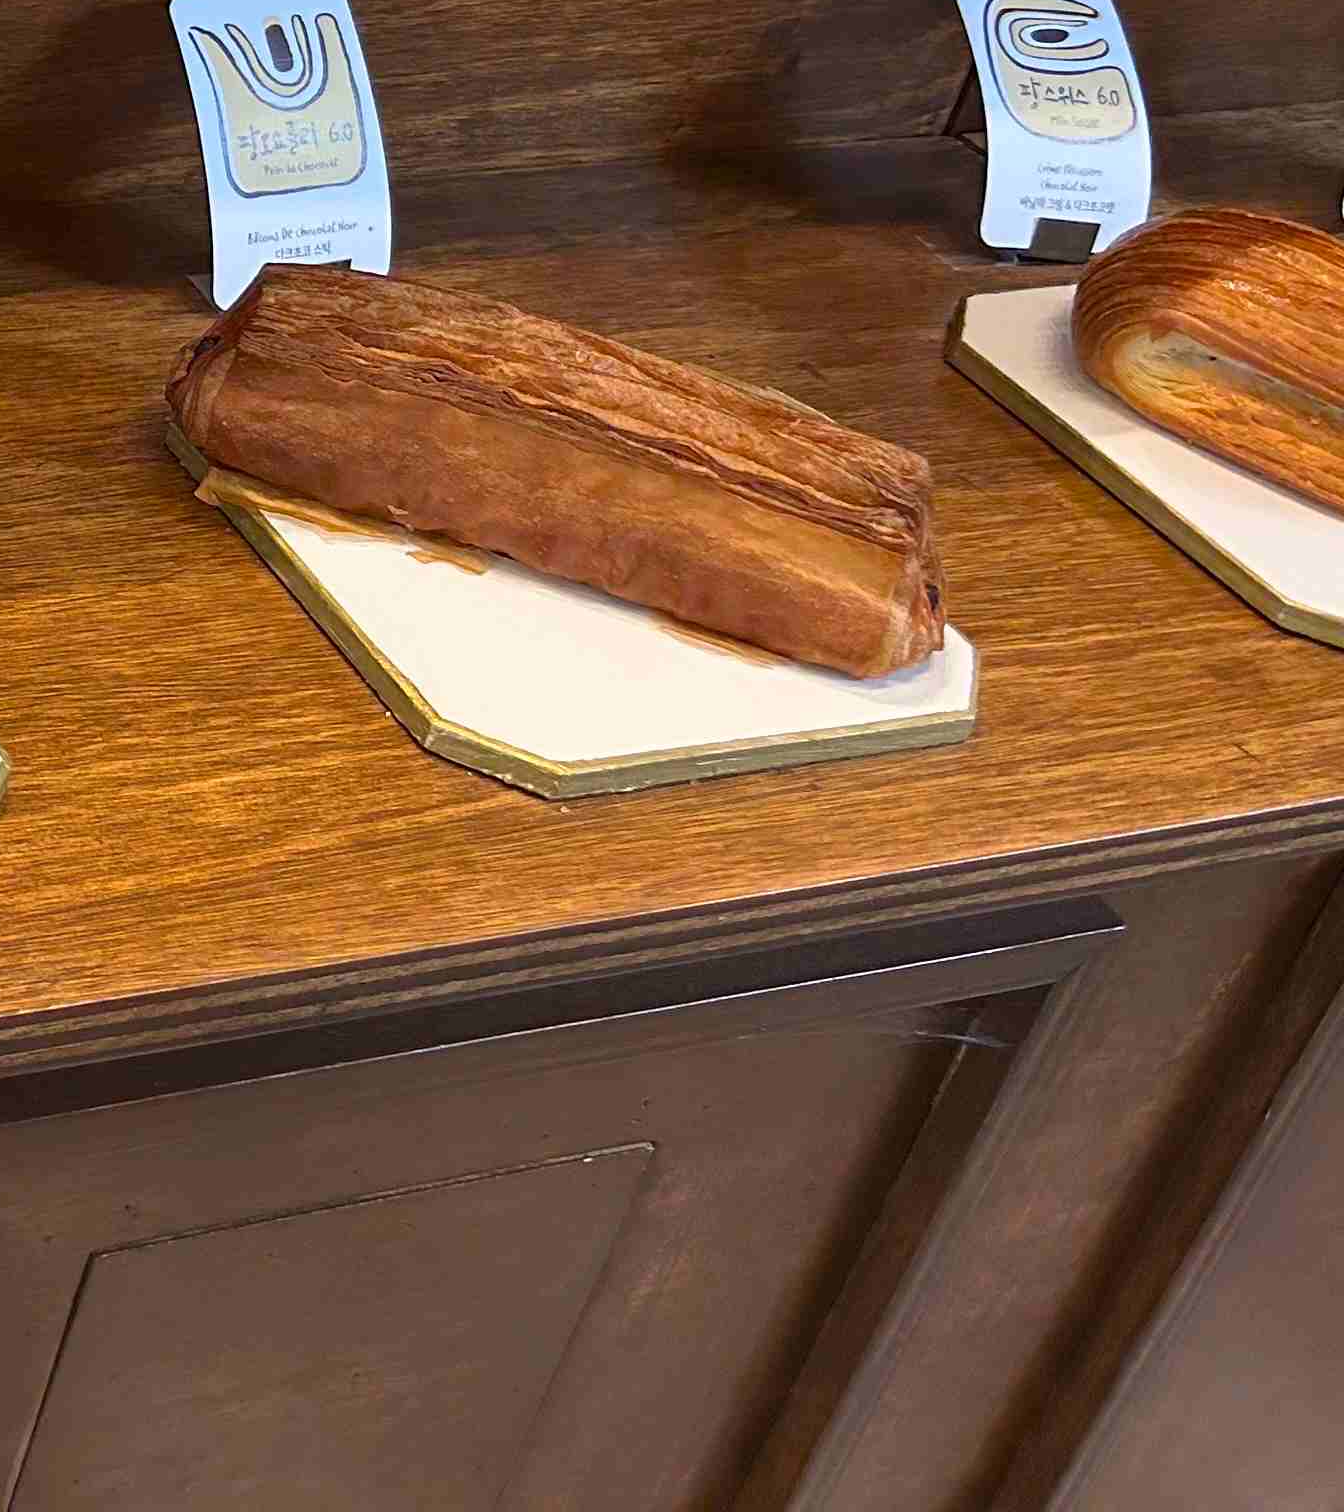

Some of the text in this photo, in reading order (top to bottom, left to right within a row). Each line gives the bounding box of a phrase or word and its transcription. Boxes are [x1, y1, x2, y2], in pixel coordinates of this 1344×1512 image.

[1018, 77, 1120, 109] 팡스위스 6.0
[328, 121, 354, 143] 6.0
